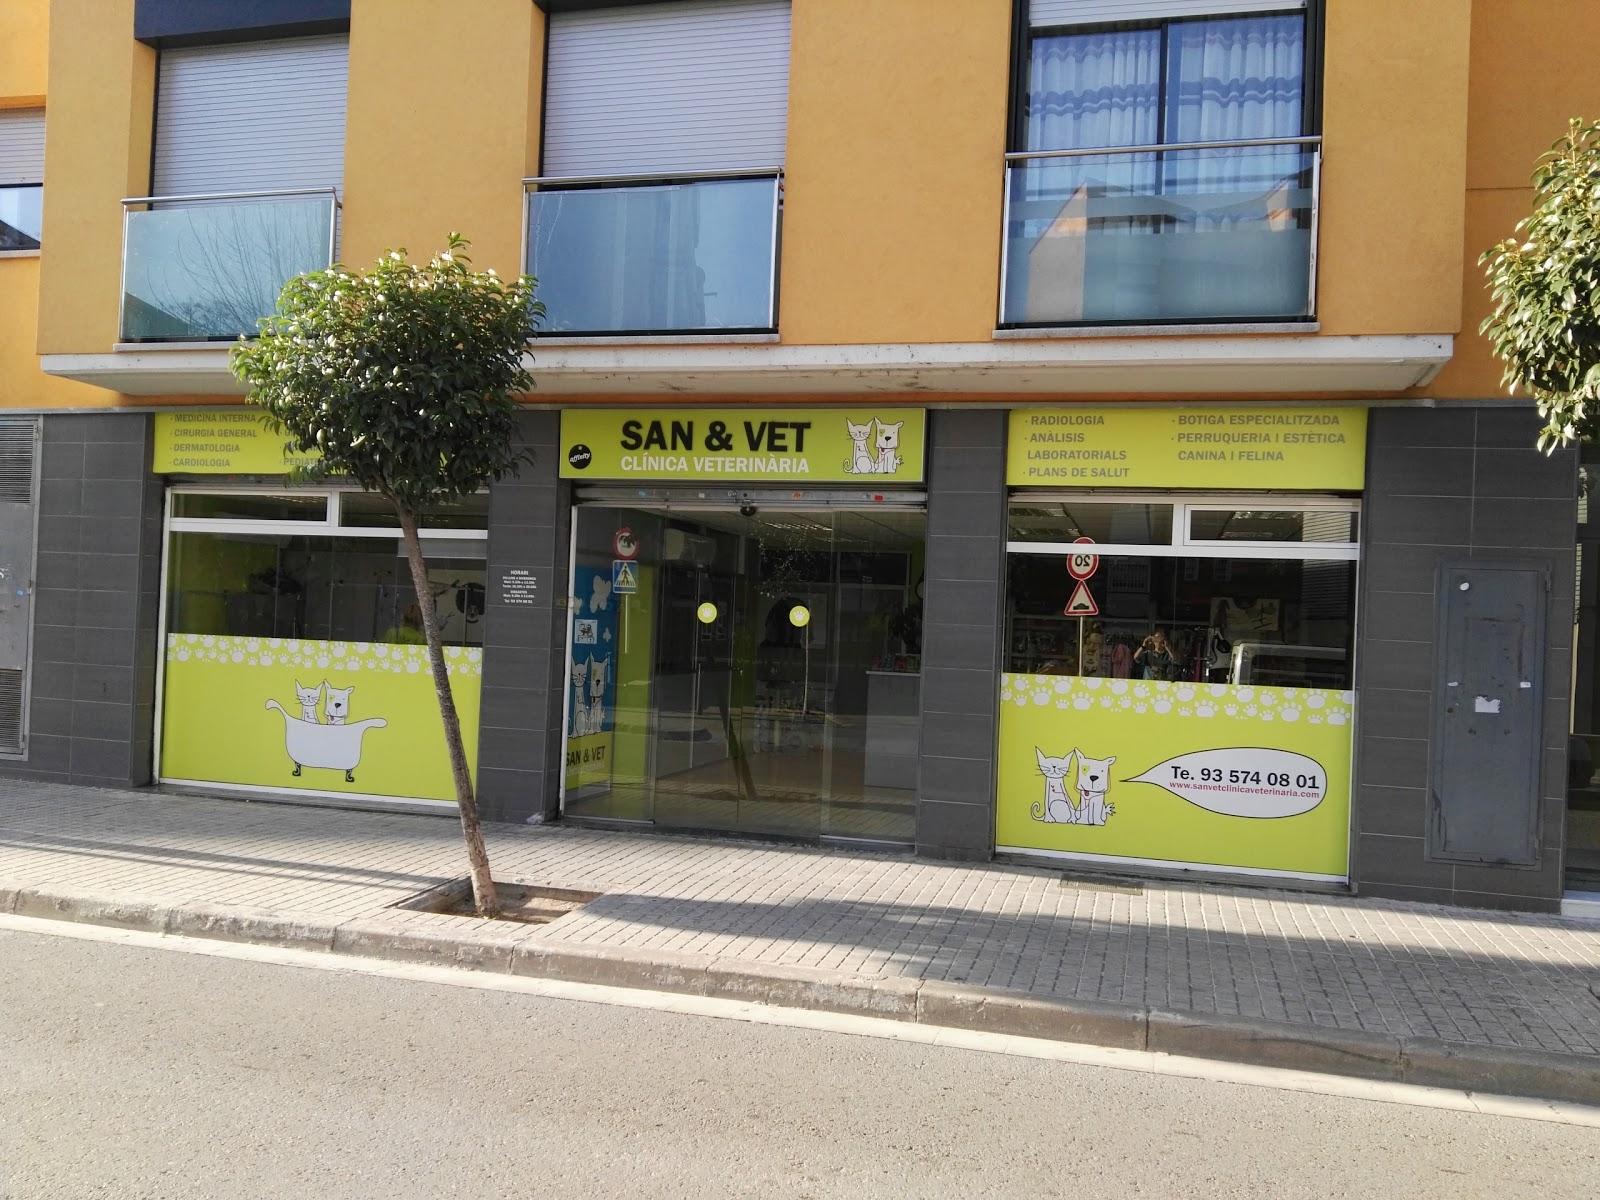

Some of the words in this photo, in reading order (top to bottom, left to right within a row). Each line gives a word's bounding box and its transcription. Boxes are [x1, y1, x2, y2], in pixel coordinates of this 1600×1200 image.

[174, 413, 217, 423] MEDICINA
[219, 413, 256, 423] INTERNA
[1031, 415, 1105, 426] RADIOLOGIA
[1178, 415, 1226, 425] BOTIGA
[1229, 415, 1340, 426] ESPECIALITZADA
[174, 428, 215, 438] CIRURGIA
[217, 429, 257, 438] GENERAL
[620, 420, 694, 451] SAN
[704, 421, 733, 452] &
[744, 421, 812, 453] VET
[1177, 432, 1272, 444] PERRUQUERIA
[1275, 433, 1279, 443] I
[173, 443, 240, 453] DERMATOLOGIA
[1027, 450, 1127, 461] LABORATORIALS
[1178, 450, 1226, 461] CANINA
[1238, 451, 1285, 461] FELINA
[173, 458, 231, 467] CARDIOLOGIA
[620, 452, 689, 473] CLÍNICA
[693, 452, 810, 474] VETERINÀRIA
[1029, 467, 1068, 477] PLANS
[1071, 467, 1087, 477] DE
[1090, 467, 1130, 478] SALUT
[566, 750, 581, 767] SAN
[583, 748, 590, 763] &
[591, 745, 606, 761] VET
[1171, 765, 1195, 780] Te.
[1200, 767, 1223, 782] 93
[1229, 769, 1262, 785] 574
[1267, 772, 1290, 787] 08
[1296, 774, 1320, 789] 01
[1169, 781, 1320, 799] www.sanvetclinicaveterinaria.com
